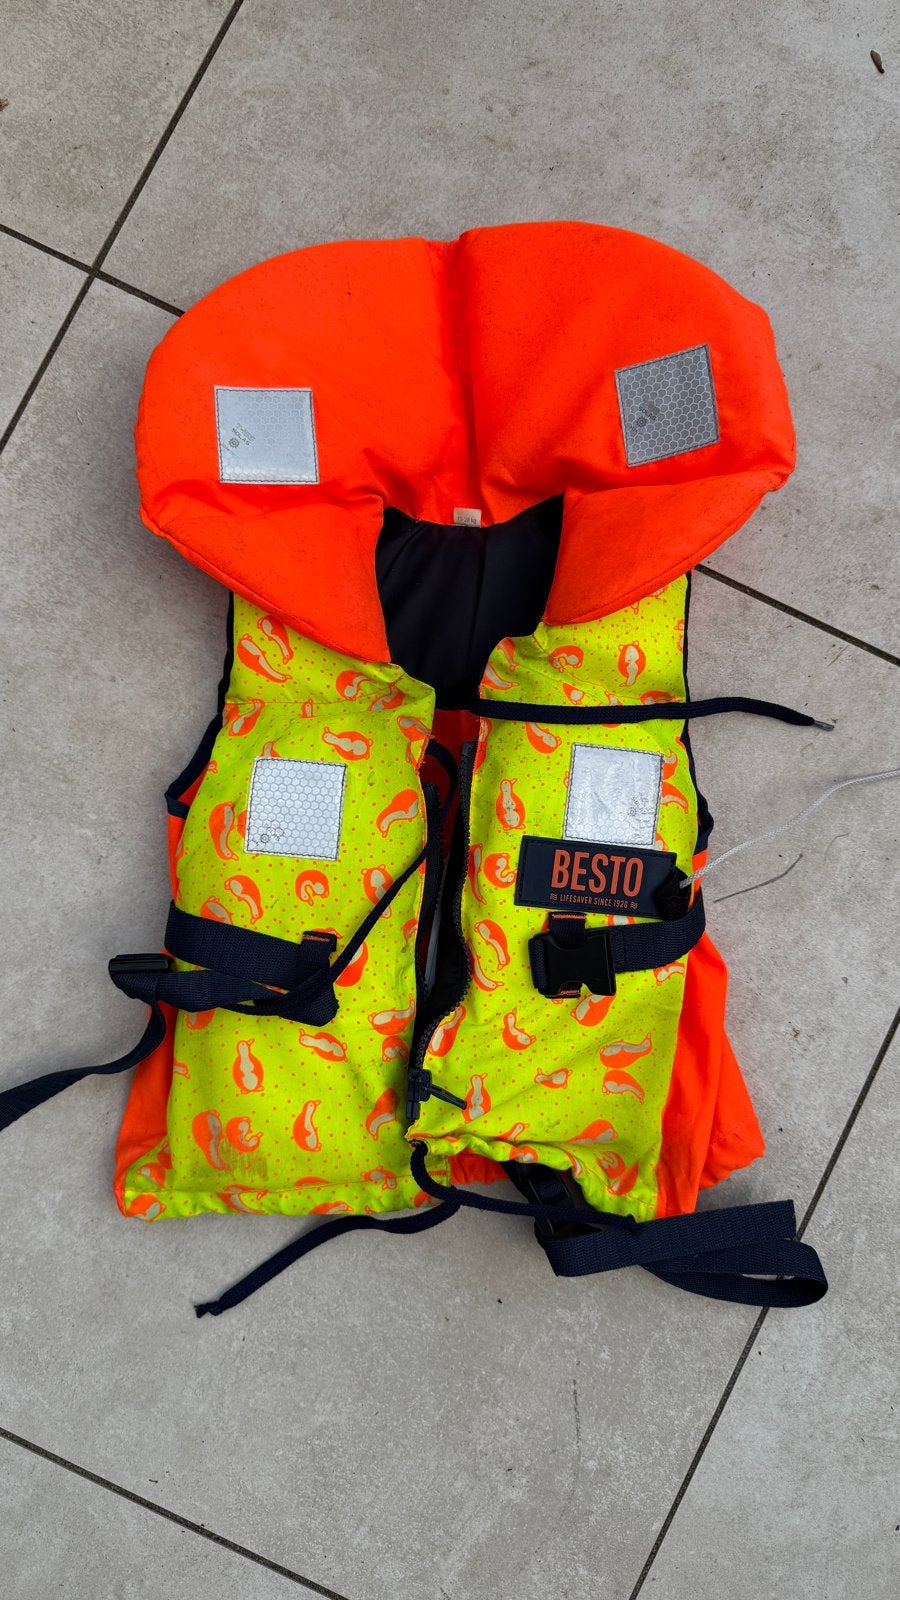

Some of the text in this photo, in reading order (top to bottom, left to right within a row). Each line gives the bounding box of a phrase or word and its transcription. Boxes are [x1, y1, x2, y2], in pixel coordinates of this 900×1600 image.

[551, 849, 644, 897] BESTO
[560, 894, 628, 909] LIFESAVER SINCE 1920
